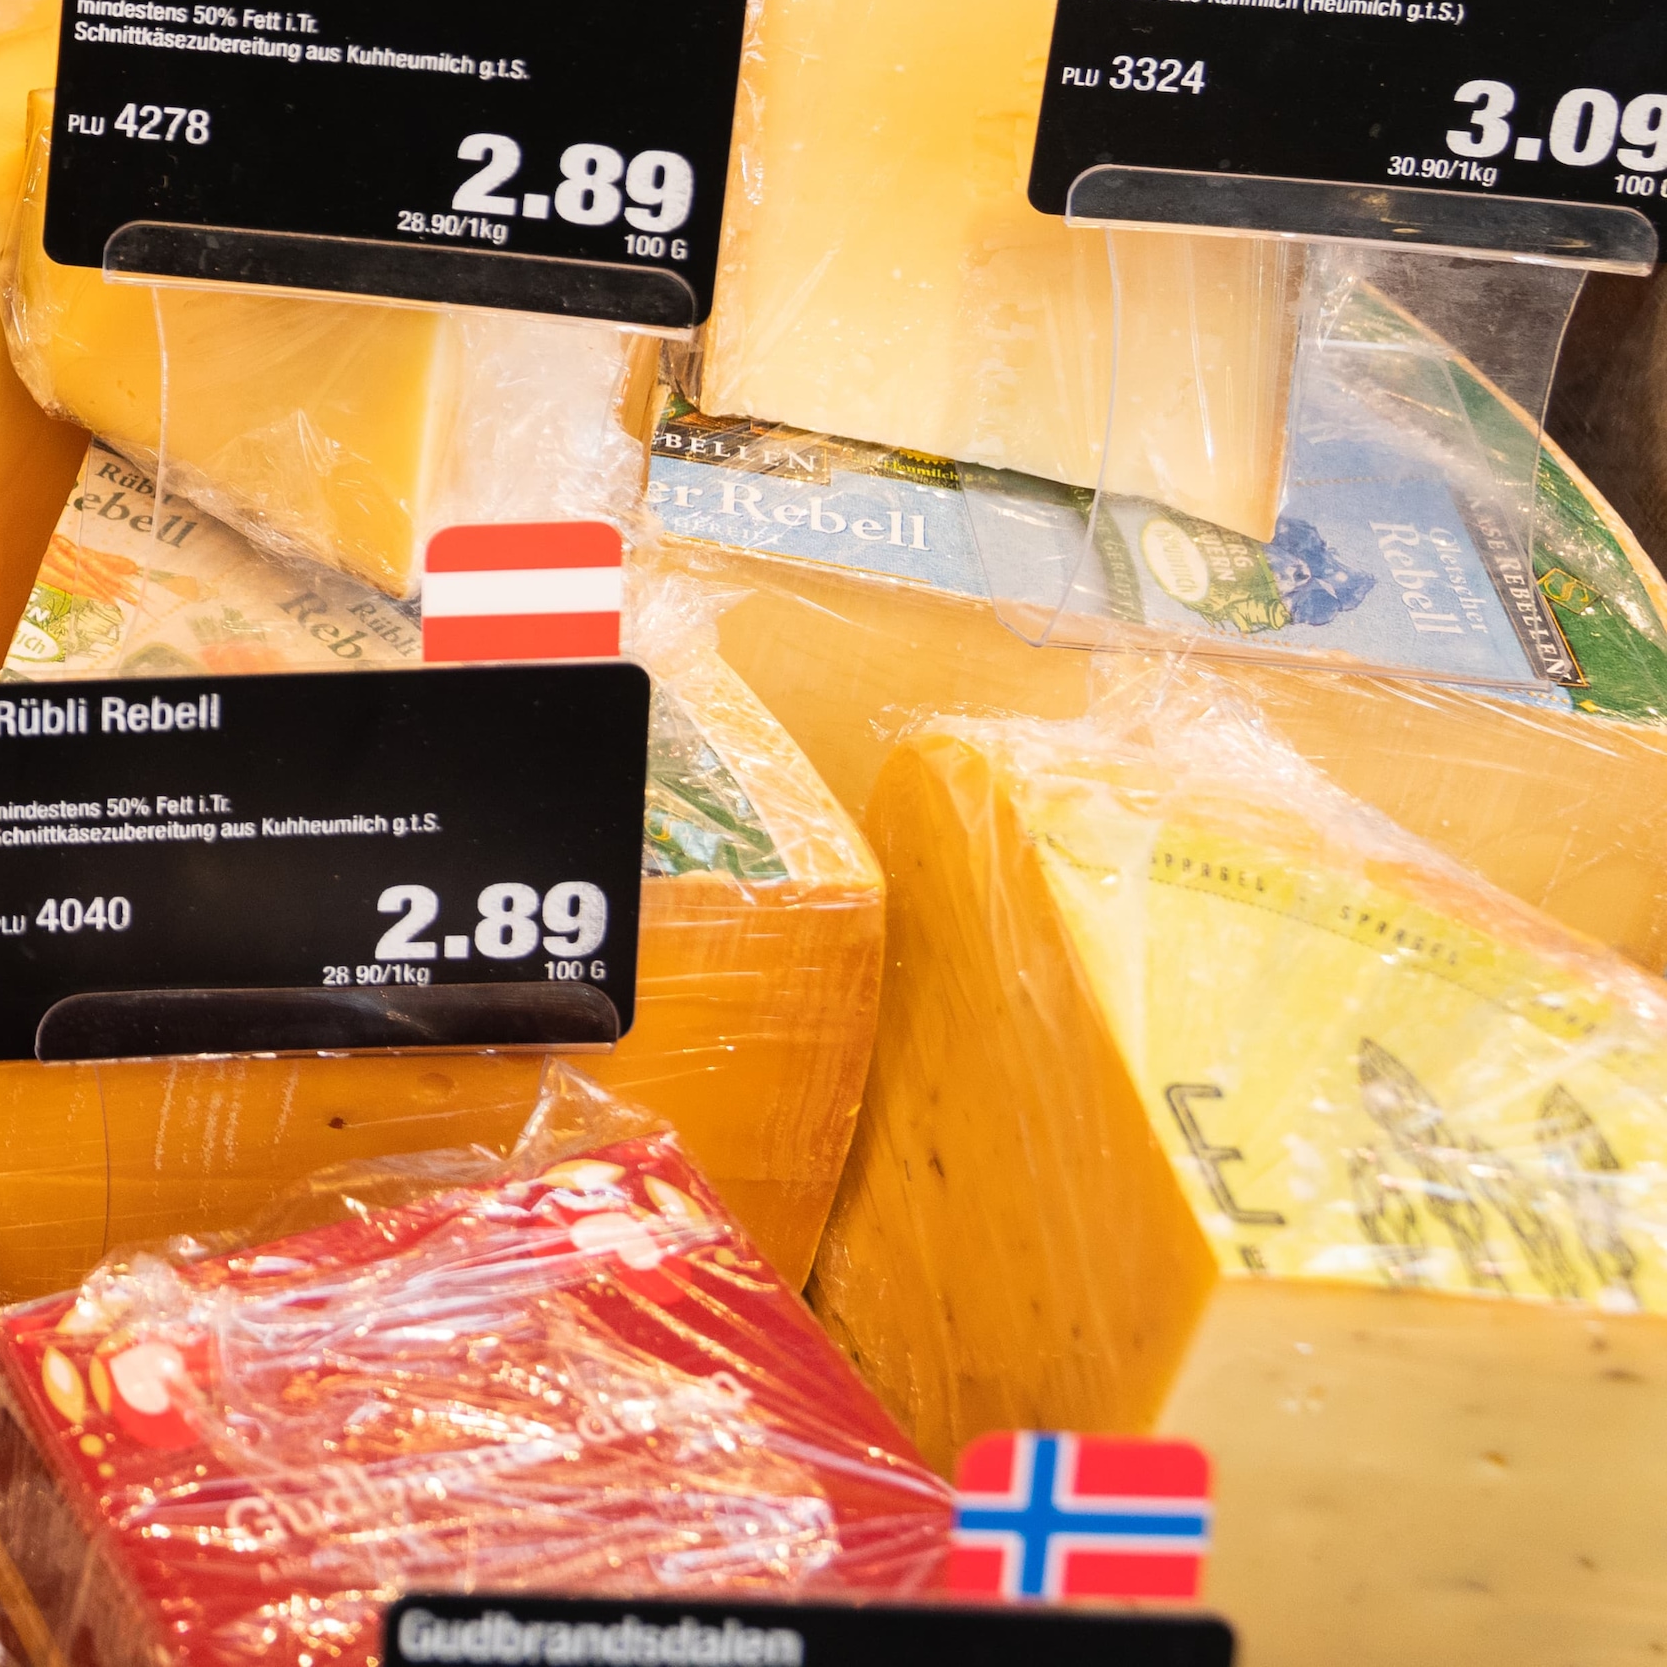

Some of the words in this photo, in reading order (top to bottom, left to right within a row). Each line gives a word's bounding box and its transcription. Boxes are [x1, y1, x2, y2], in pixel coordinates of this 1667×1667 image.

[193, 5, 237, 27] 50%
[243, 9, 281, 31] Fett
[1407, 2, 1464, 25] g.t.S.)
[74, 21, 302, 62] Schnittkäsezubereitung
[305, 45, 341, 62] aus
[347, 45, 475, 73] Kuhheumilch
[479, 59, 527, 80] g.t.S.
[1109, 56, 1205, 94] 3324
[114, 103, 209, 144] 4278
[452, 133, 693, 233] 2.89
[1387, 156, 1497, 187] 30.90/1kg
[397, 211, 507, 244] 28.90/1kg
[720, 480, 931, 551] Rebell
[102, 694, 219, 732] Rebell
[36, 897, 130, 932] 4040
[375, 881, 607, 960] 2.89
